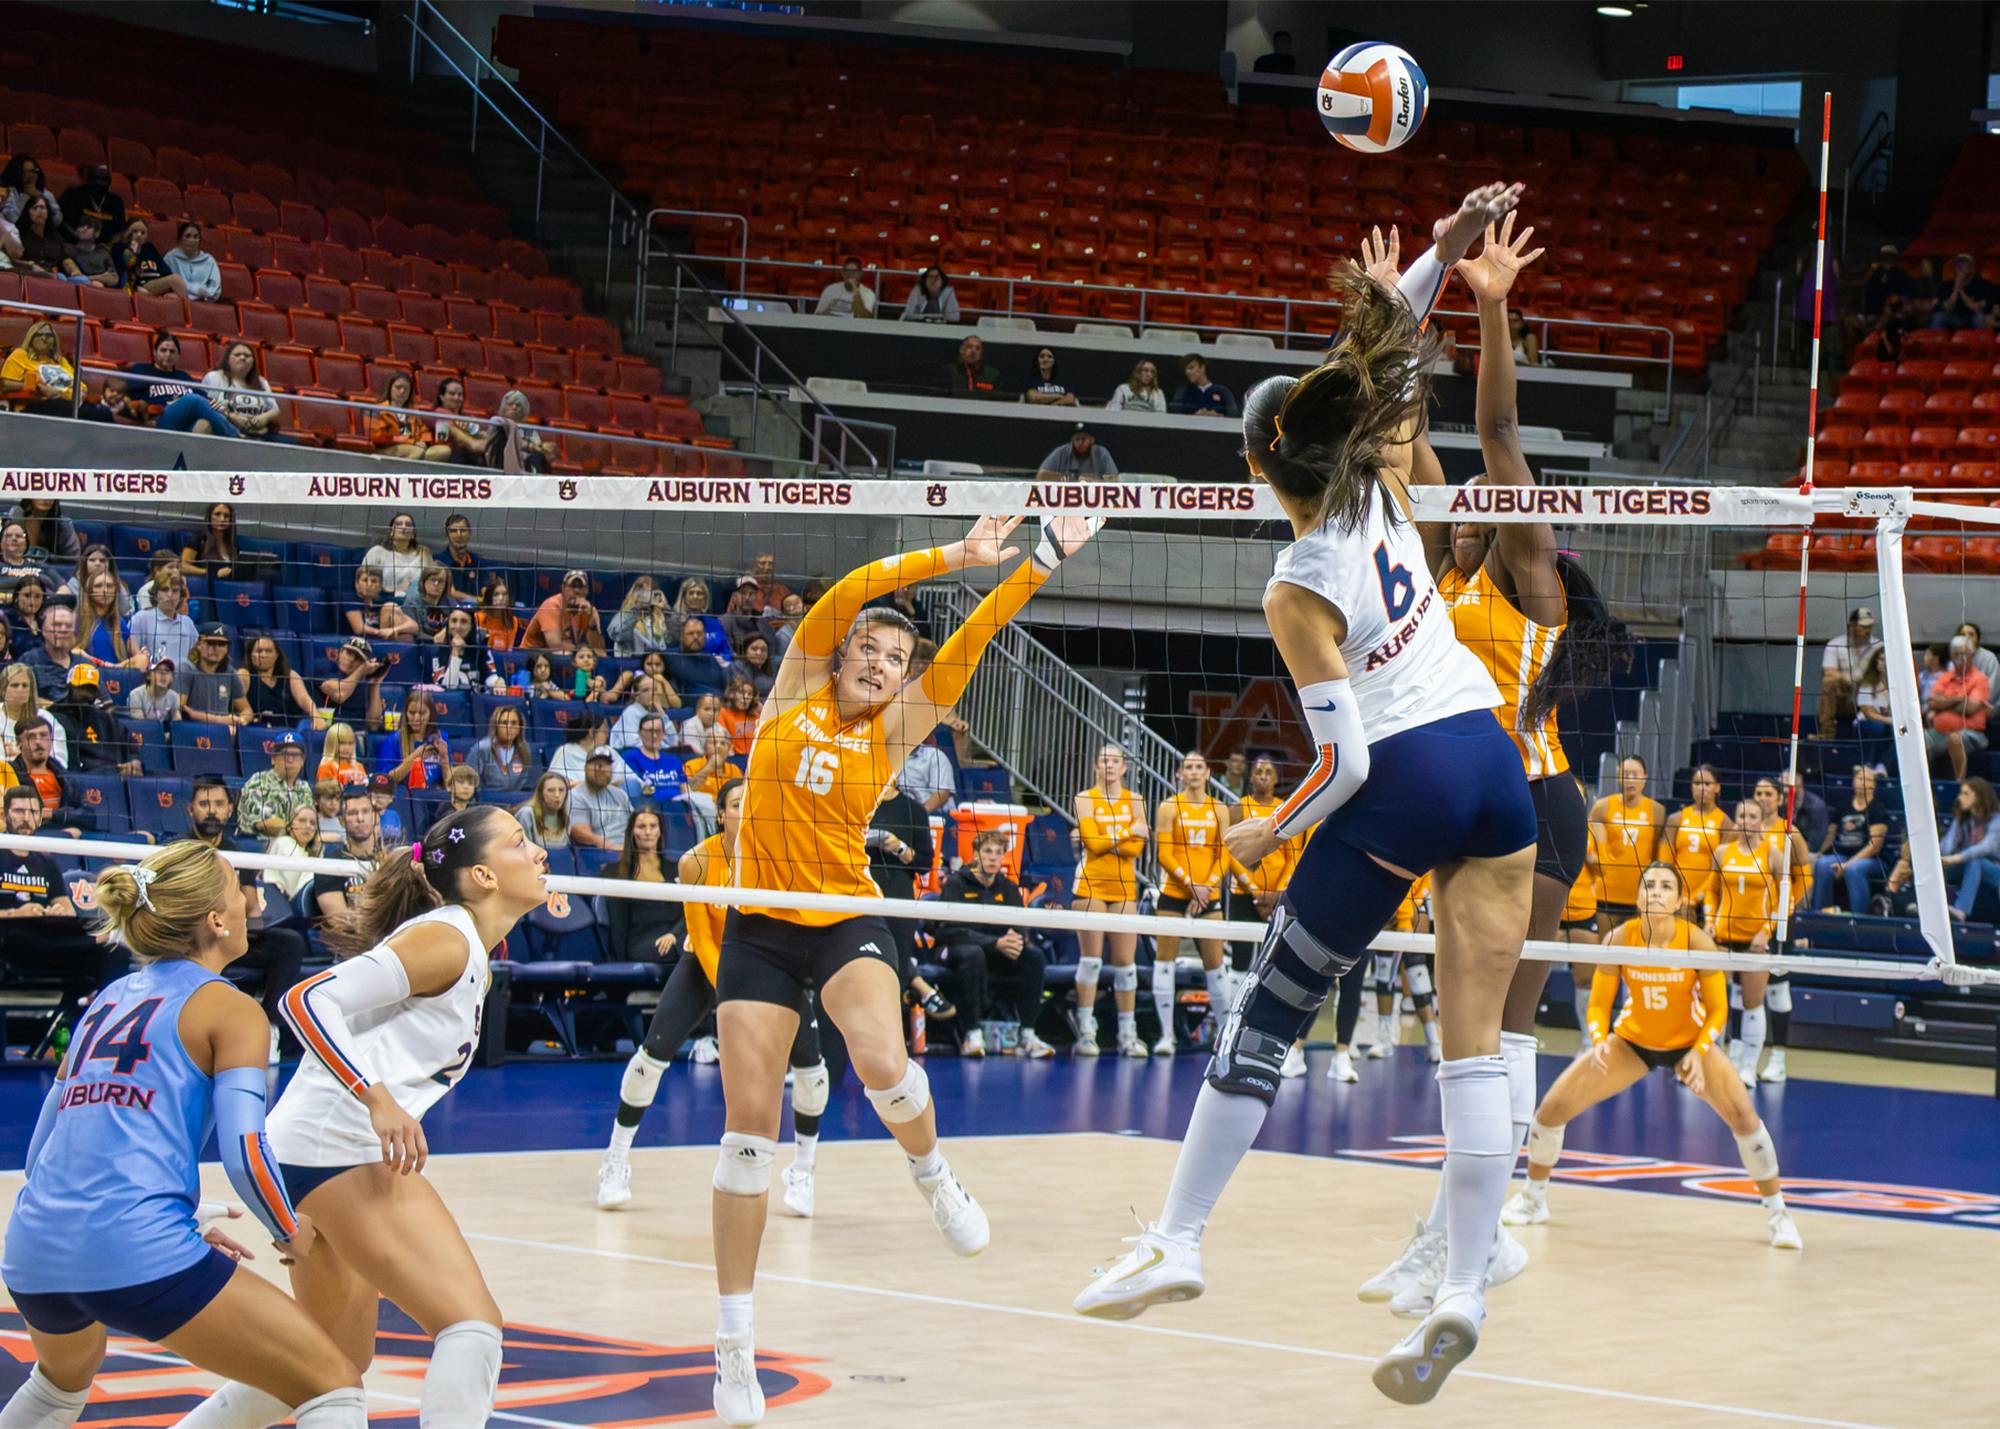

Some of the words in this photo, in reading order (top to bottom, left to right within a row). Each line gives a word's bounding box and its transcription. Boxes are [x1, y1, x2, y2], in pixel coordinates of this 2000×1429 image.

[1397, 77, 1409, 127] Baden
[1, 472, 86, 492] AUBURN
[94, 473, 168, 494] TIGERS
[308, 477, 400, 498] AUBURN
[408, 478, 492, 499] TIGERS
[647, 480, 751, 503] AUBURN
[759, 482, 852, 506] TIGERS
[1025, 485, 1142, 509] AUBURN
[1151, 486, 1255, 511] TIGERS
[1449, 488, 1584, 515] AUBURN
[1592, 490, 1712, 515] TIGERS
[1373, 539, 1416, 623] 6
[1364, 586, 1435, 673] AUBUR
[794, 745, 839, 796] 16
[1188, 828, 1206, 845] 14
[1687, 833, 1700, 853] 3
[1642, 985, 1668, 1010] 15
[70, 997, 165, 1078] 14
[58, 1082, 156, 1112] UBURN
